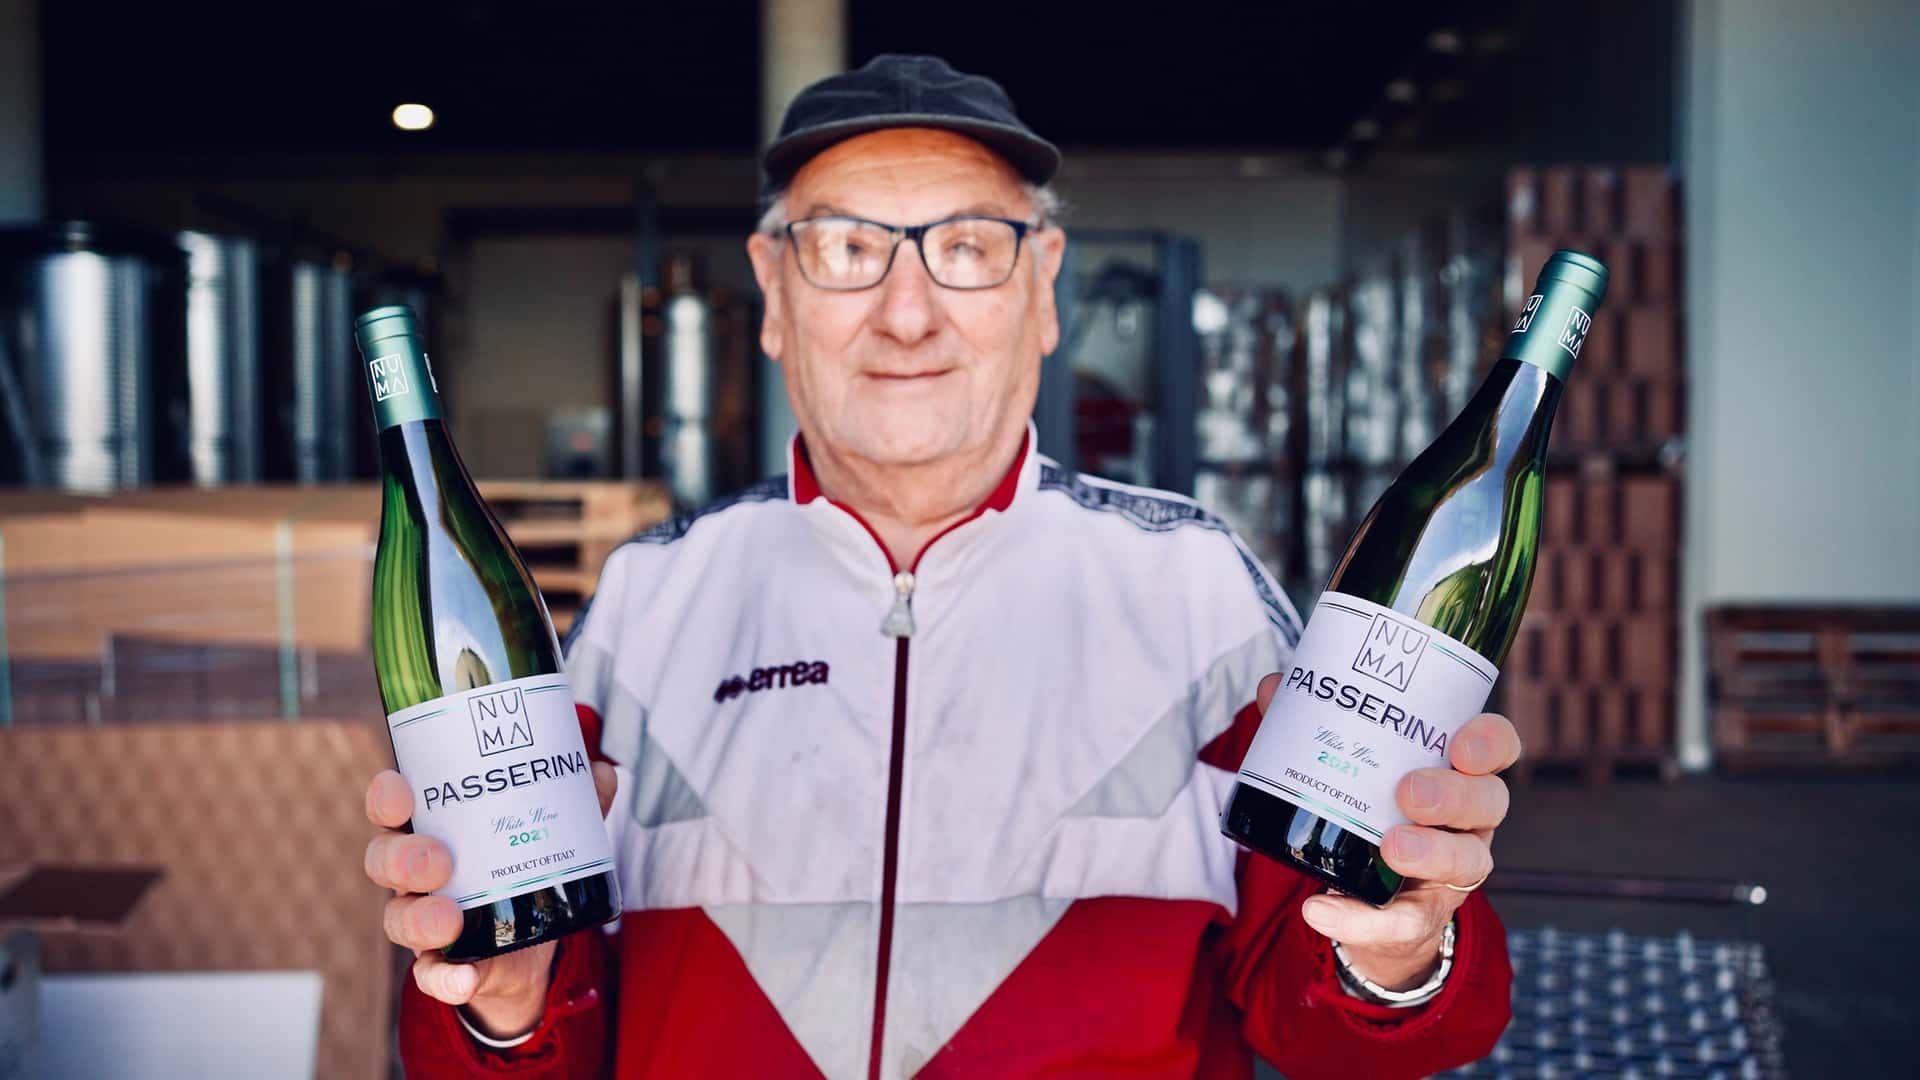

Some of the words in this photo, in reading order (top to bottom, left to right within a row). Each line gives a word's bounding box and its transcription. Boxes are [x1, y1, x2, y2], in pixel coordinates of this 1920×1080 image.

[374, 358, 399, 378] NU
[377, 377, 405, 396] MA
[1375, 620, 1424, 654] NU
[1360, 647, 1404, 686] MA
[477, 691, 519, 720] NU
[1286, 667, 1448, 757] PASSERINA
[482, 721, 529, 750] MA
[1313, 725, 1345, 752] White
[1350, 742, 1380, 768] Wine
[1317, 751, 1359, 778] 2021
[423, 751, 587, 810] PASSERINA
[1284, 767, 1331, 793] PRODUCT
[1329, 787, 1345, 800] OF
[1343, 794, 1371, 813] ITALY
[490, 815, 525, 834] White
[528, 807, 558, 824] Wine
[509, 827, 550, 846] 2021
[490, 859, 538, 879] PRODUCT
[539, 855, 553, 866] OF
[551, 849, 576, 863] ITALY
